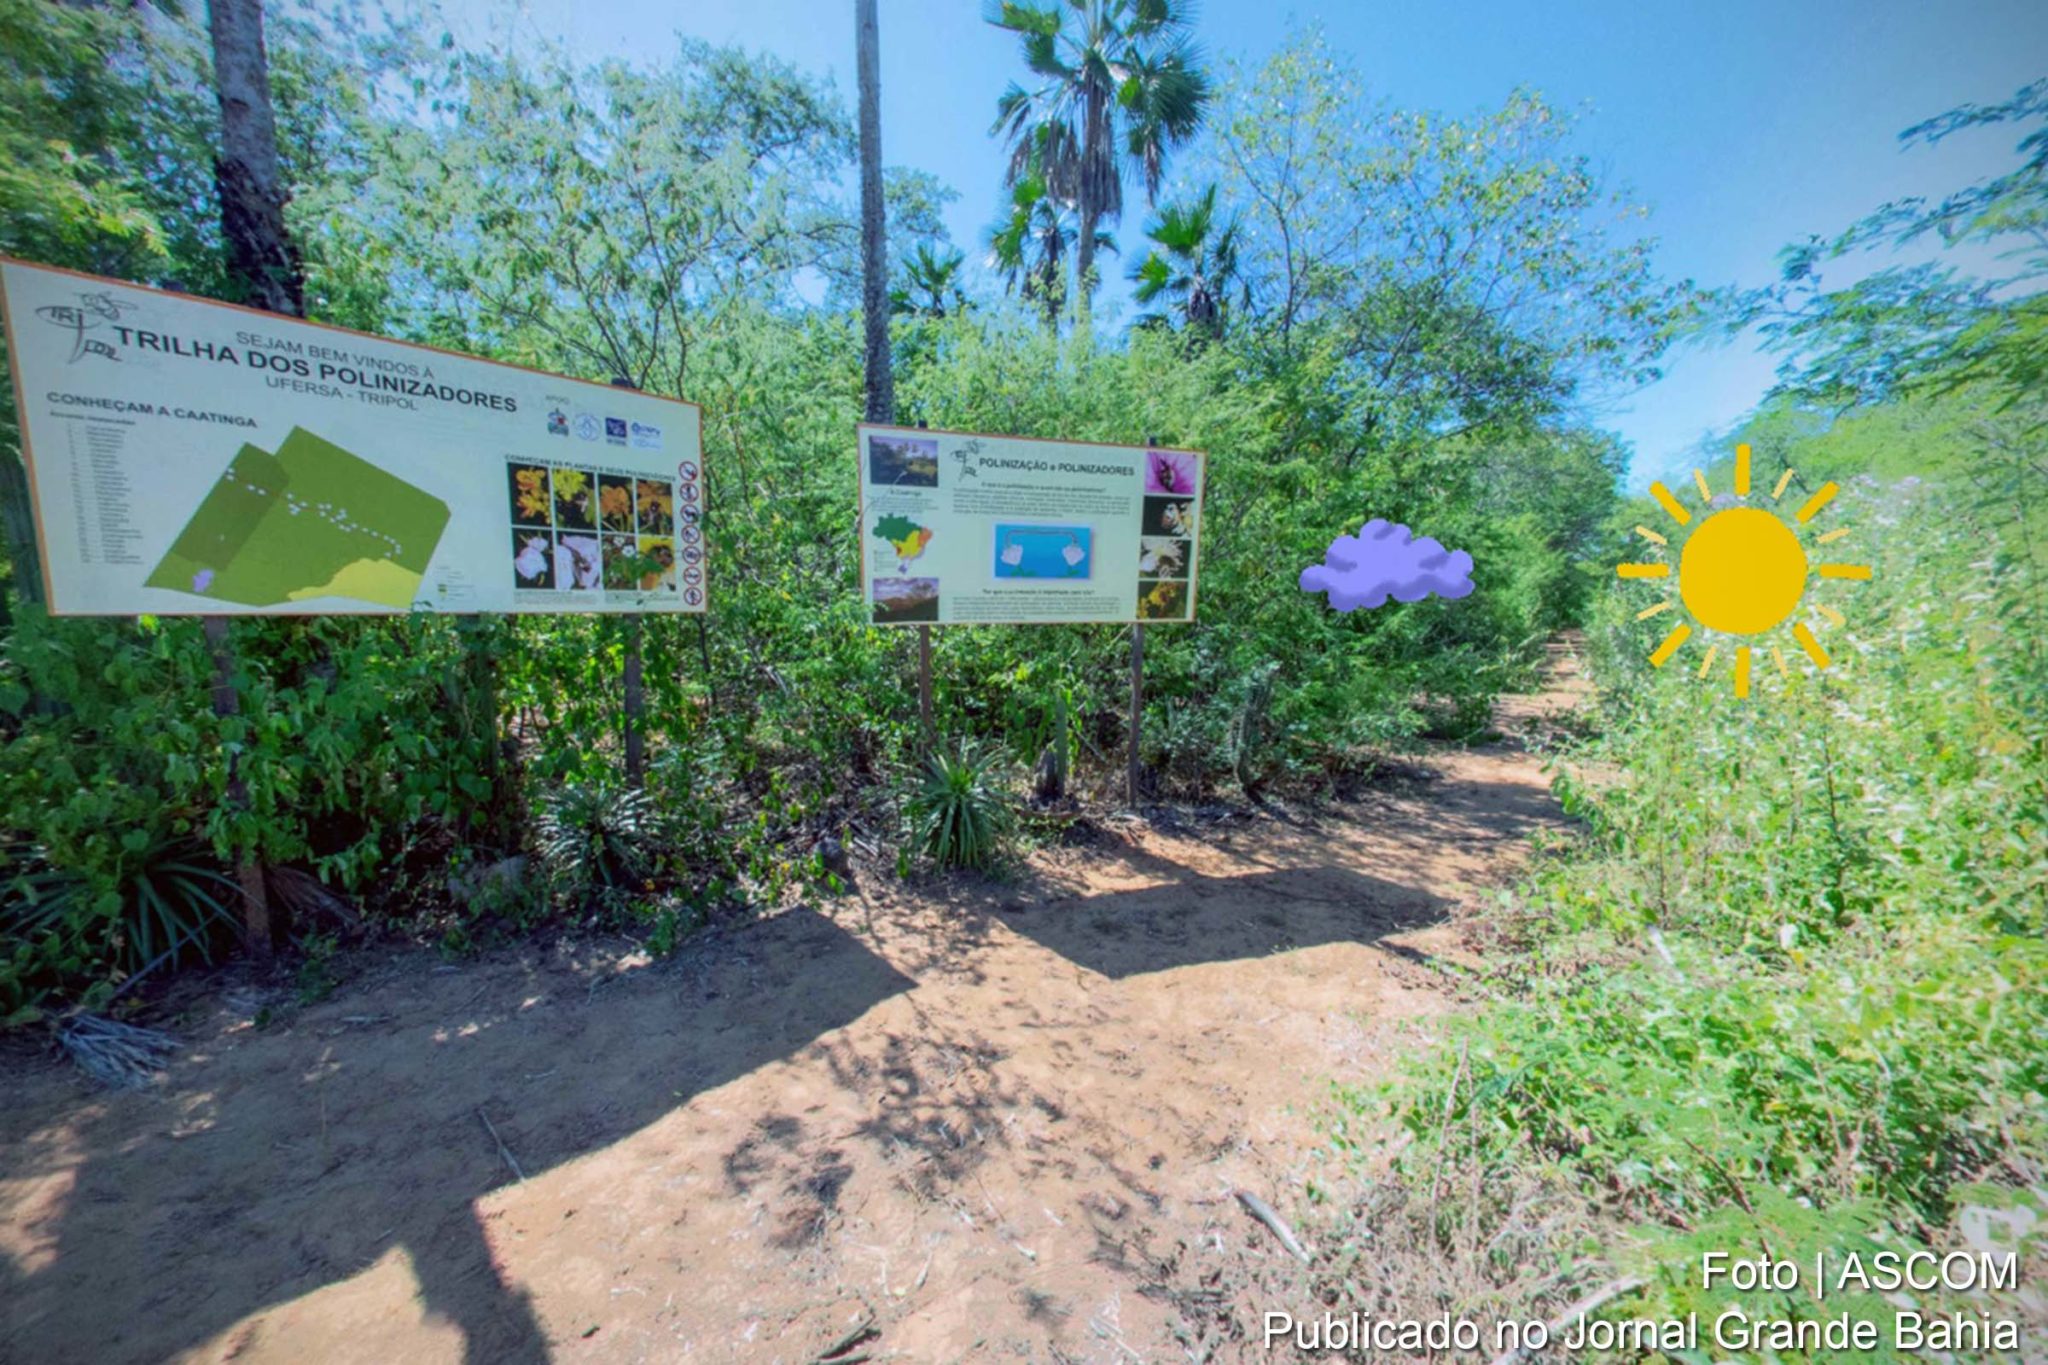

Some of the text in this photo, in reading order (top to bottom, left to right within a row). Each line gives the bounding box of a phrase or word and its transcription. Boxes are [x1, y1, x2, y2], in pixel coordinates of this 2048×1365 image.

[112, 325, 518, 412] TRILHA DOS POLINIZADORES
[236, 331, 303, 355] SEJAM
[309, 345, 349, 363] BEM
[353, 354, 419, 377] VINDOS
[47, 391, 258, 428] CONHEÇAM A CAATINGA
[265, 375, 343, 399] UFERSA
[358, 391, 419, 411] TRIPOL
[979, 457, 1048, 472] POLINIZAÇÃO
[1058, 463, 1135, 476] POLINIZADORES
